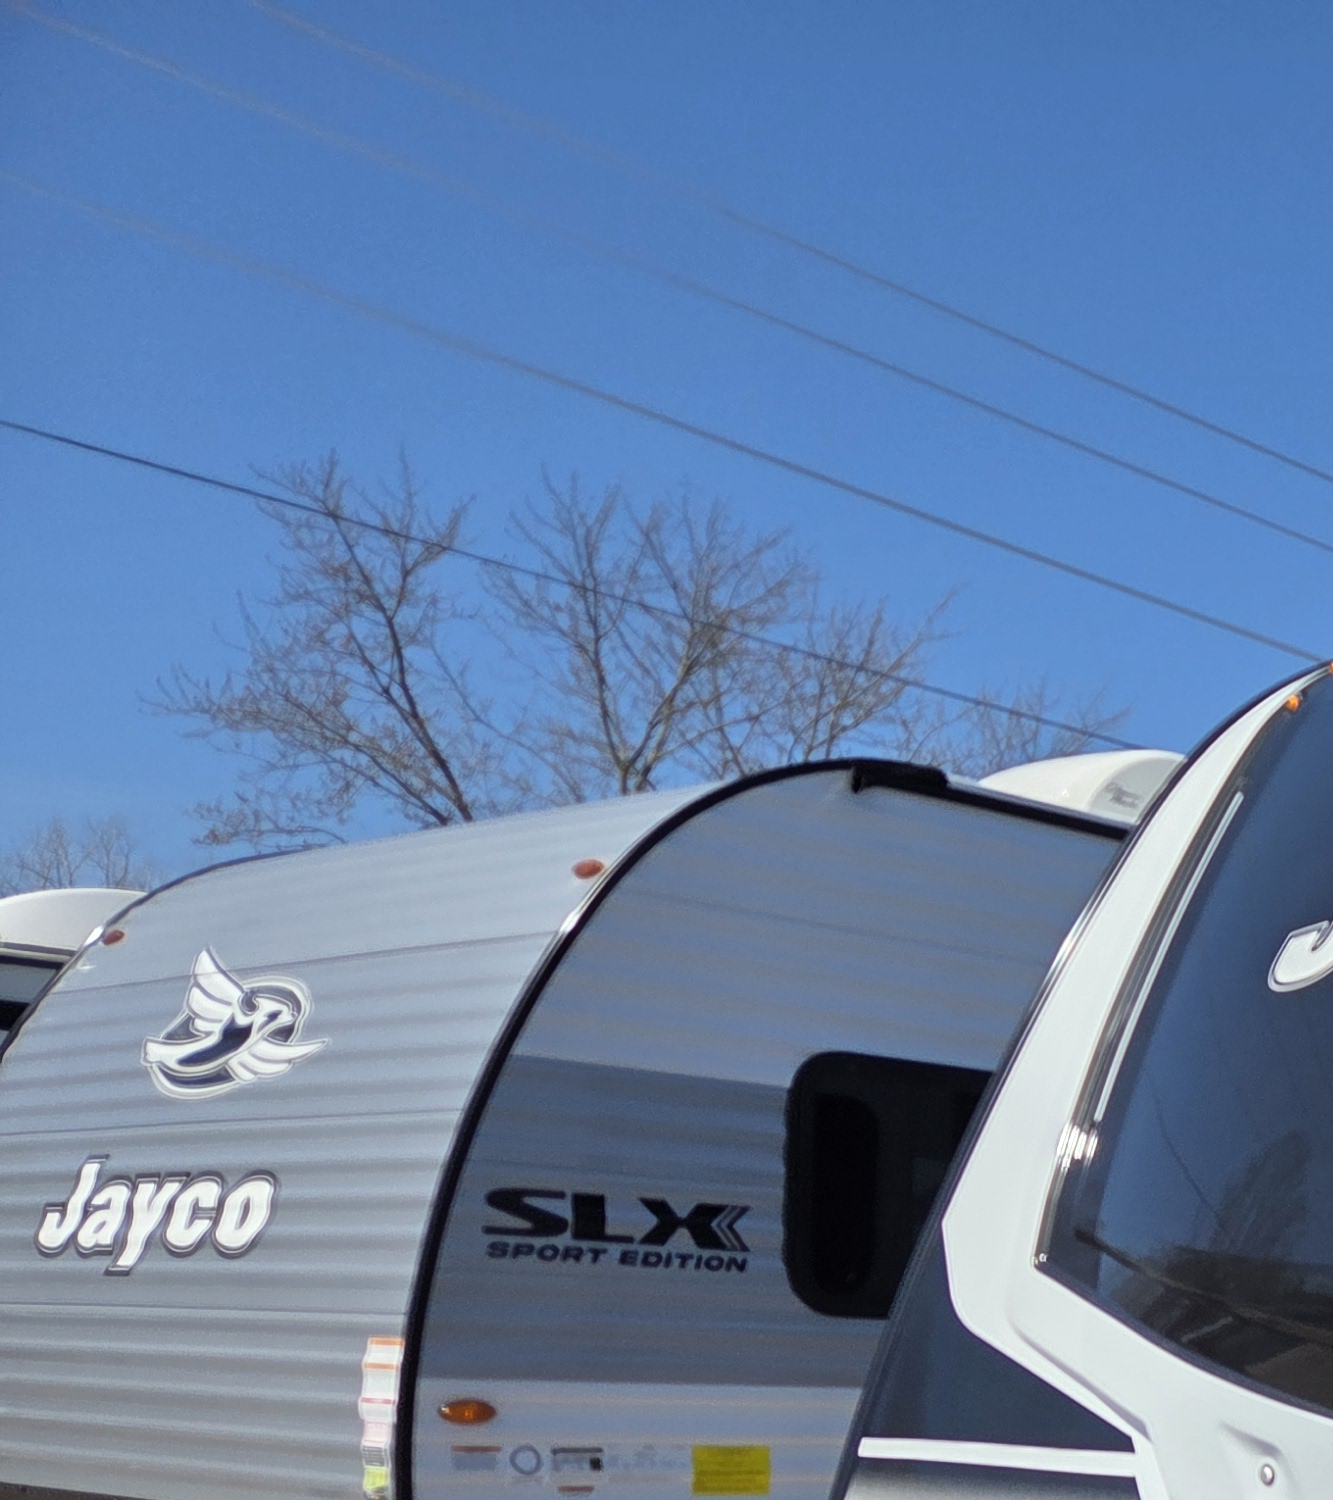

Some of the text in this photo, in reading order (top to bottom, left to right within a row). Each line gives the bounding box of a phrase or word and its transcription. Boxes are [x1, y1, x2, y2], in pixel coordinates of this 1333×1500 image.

[36, 1155, 277, 1275] Jayco
[481, 1186, 751, 1252] SLX
[486, 1241, 748, 1273] SPORT EDITION
